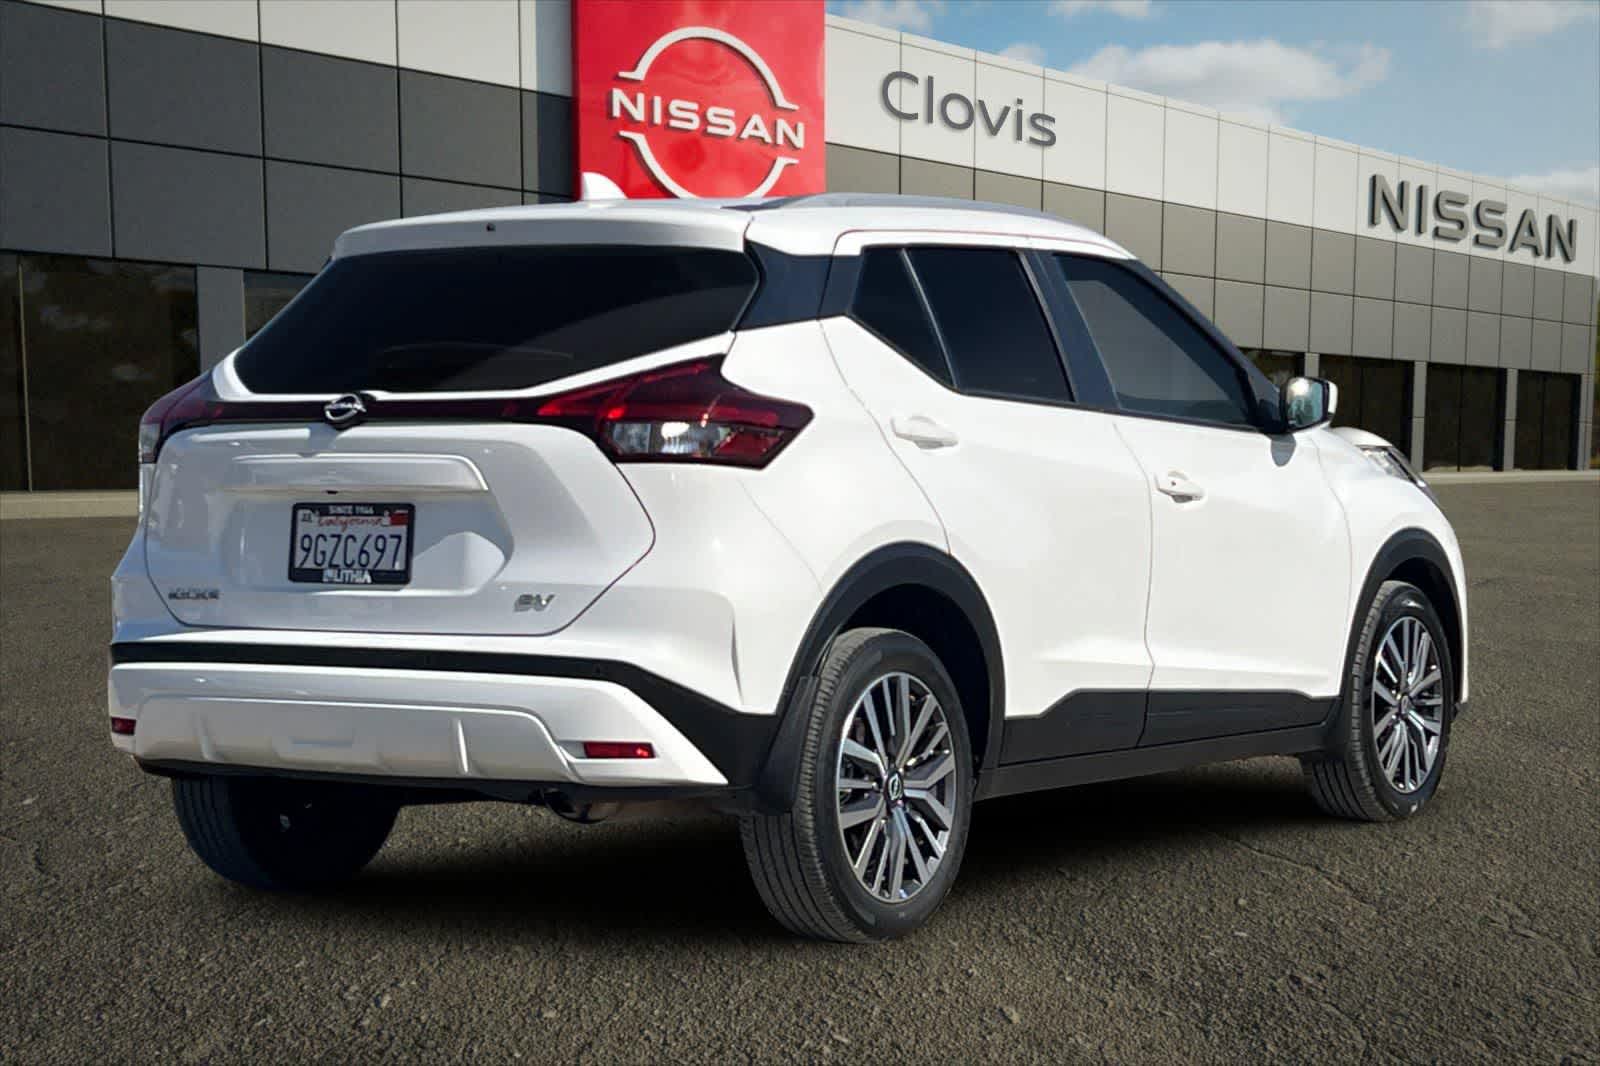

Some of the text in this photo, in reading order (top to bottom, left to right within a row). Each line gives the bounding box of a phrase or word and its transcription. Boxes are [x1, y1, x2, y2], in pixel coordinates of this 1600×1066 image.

[610, 87, 806, 150] NISSAN
[880, 70, 1057, 147] Clovis
[1368, 173, 1578, 263] NISSAN
[300, 534, 402, 569] 9GZC697
